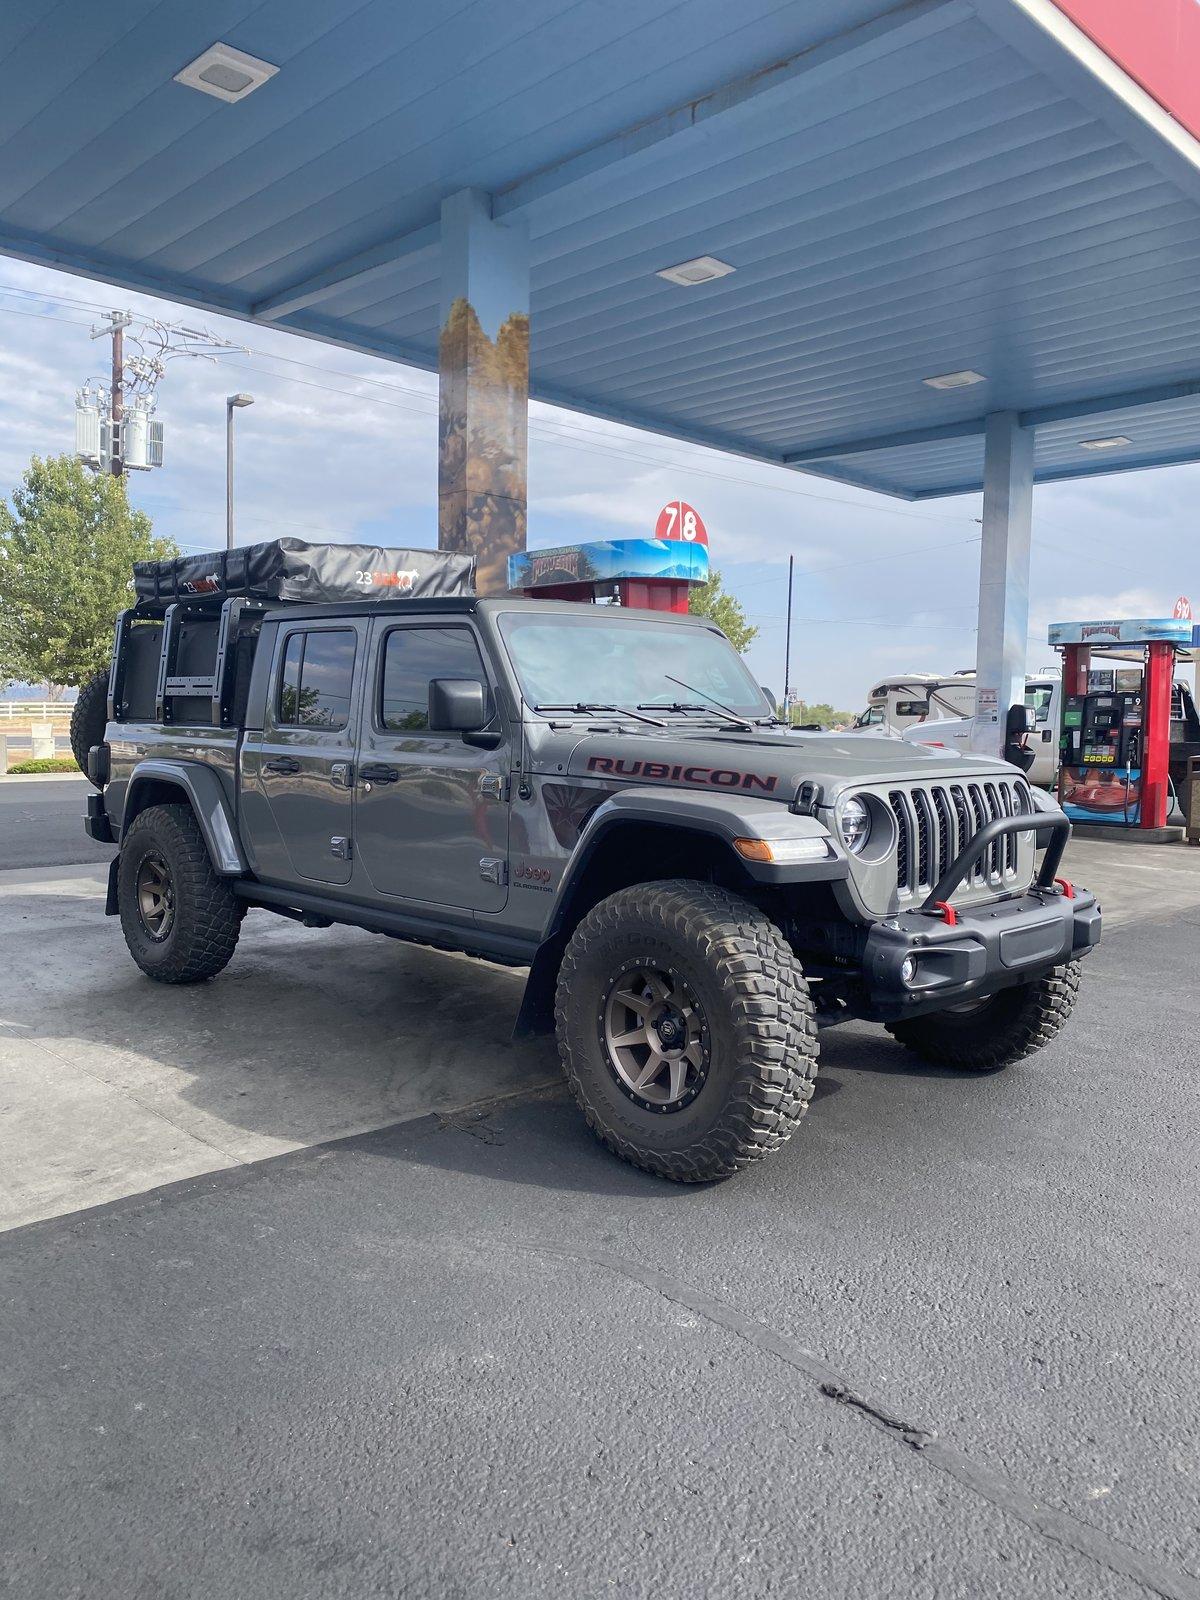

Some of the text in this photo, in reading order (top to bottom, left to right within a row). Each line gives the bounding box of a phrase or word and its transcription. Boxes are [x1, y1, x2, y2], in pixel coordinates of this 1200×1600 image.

[665, 506, 697, 541] 7 8
[586, 756, 779, 792] RUBICON
[515, 860, 551, 885] Jeep
